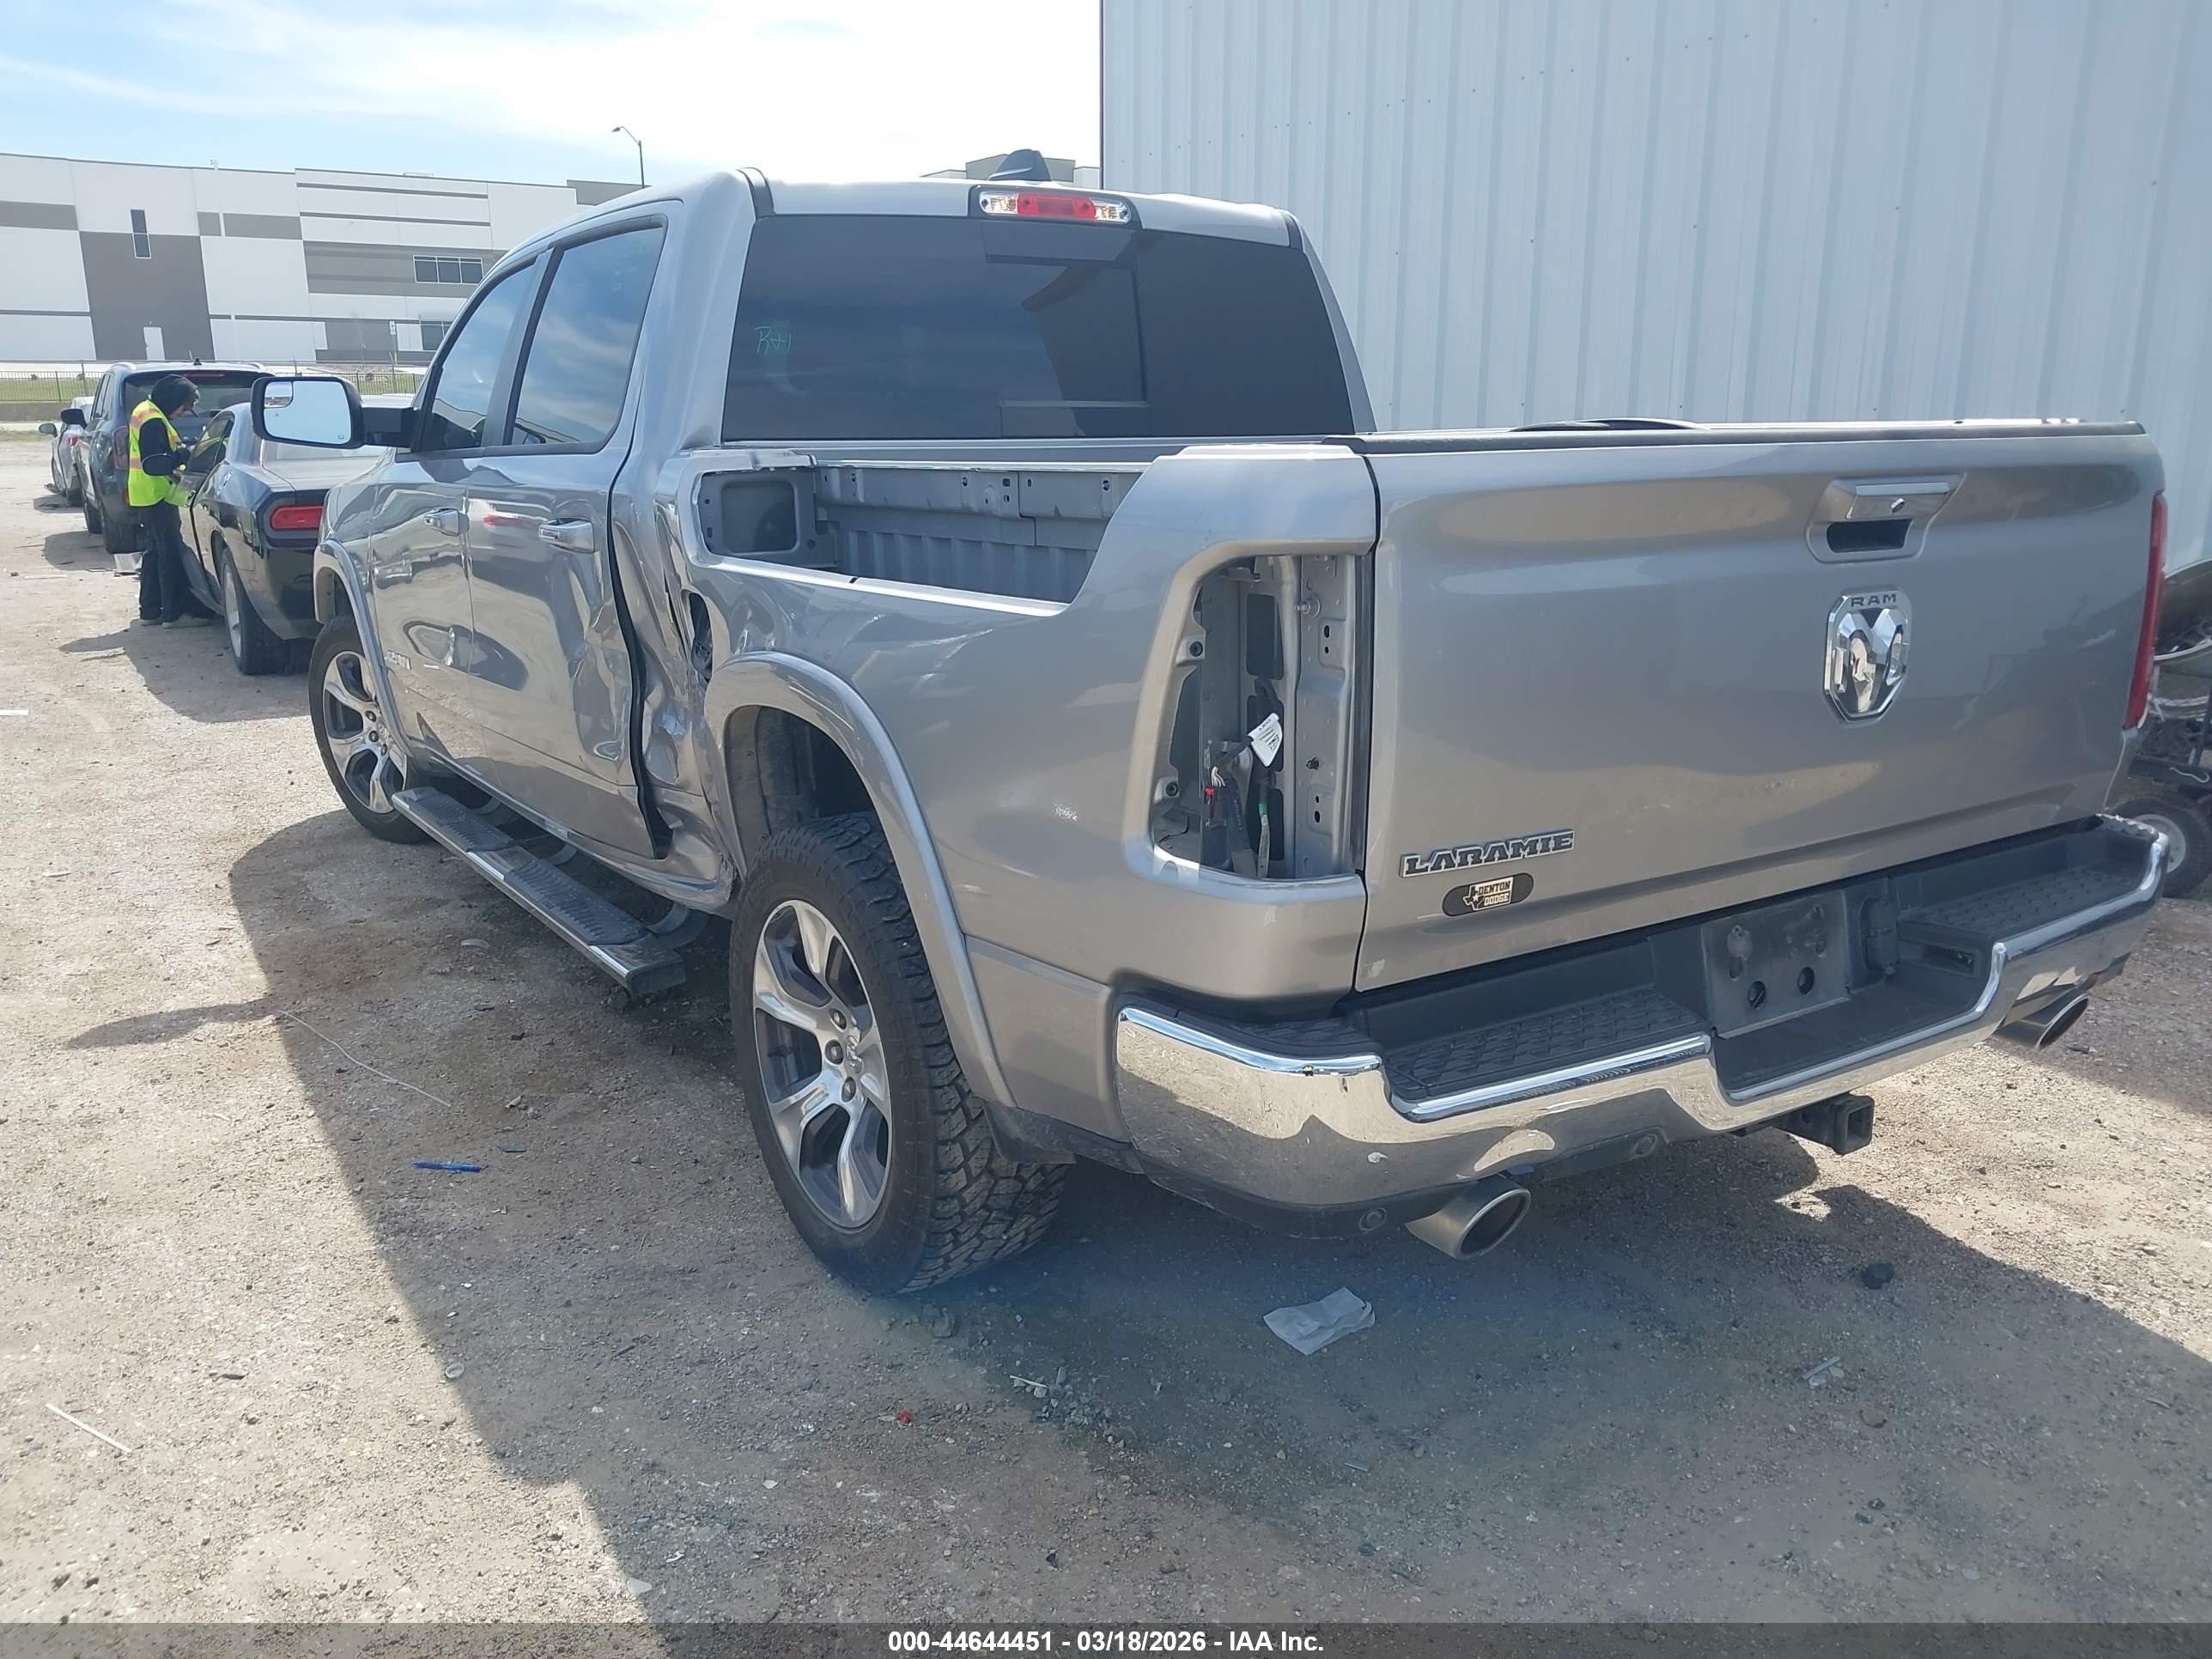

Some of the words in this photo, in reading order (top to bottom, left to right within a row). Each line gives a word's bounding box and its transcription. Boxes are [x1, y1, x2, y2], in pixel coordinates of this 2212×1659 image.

[1850, 592, 1897, 607] RAM
[1401, 830, 1575, 877] LARAMIE
[1477, 880, 1511, 896] DENTON
[1483, 892, 1510, 906] DODGE
